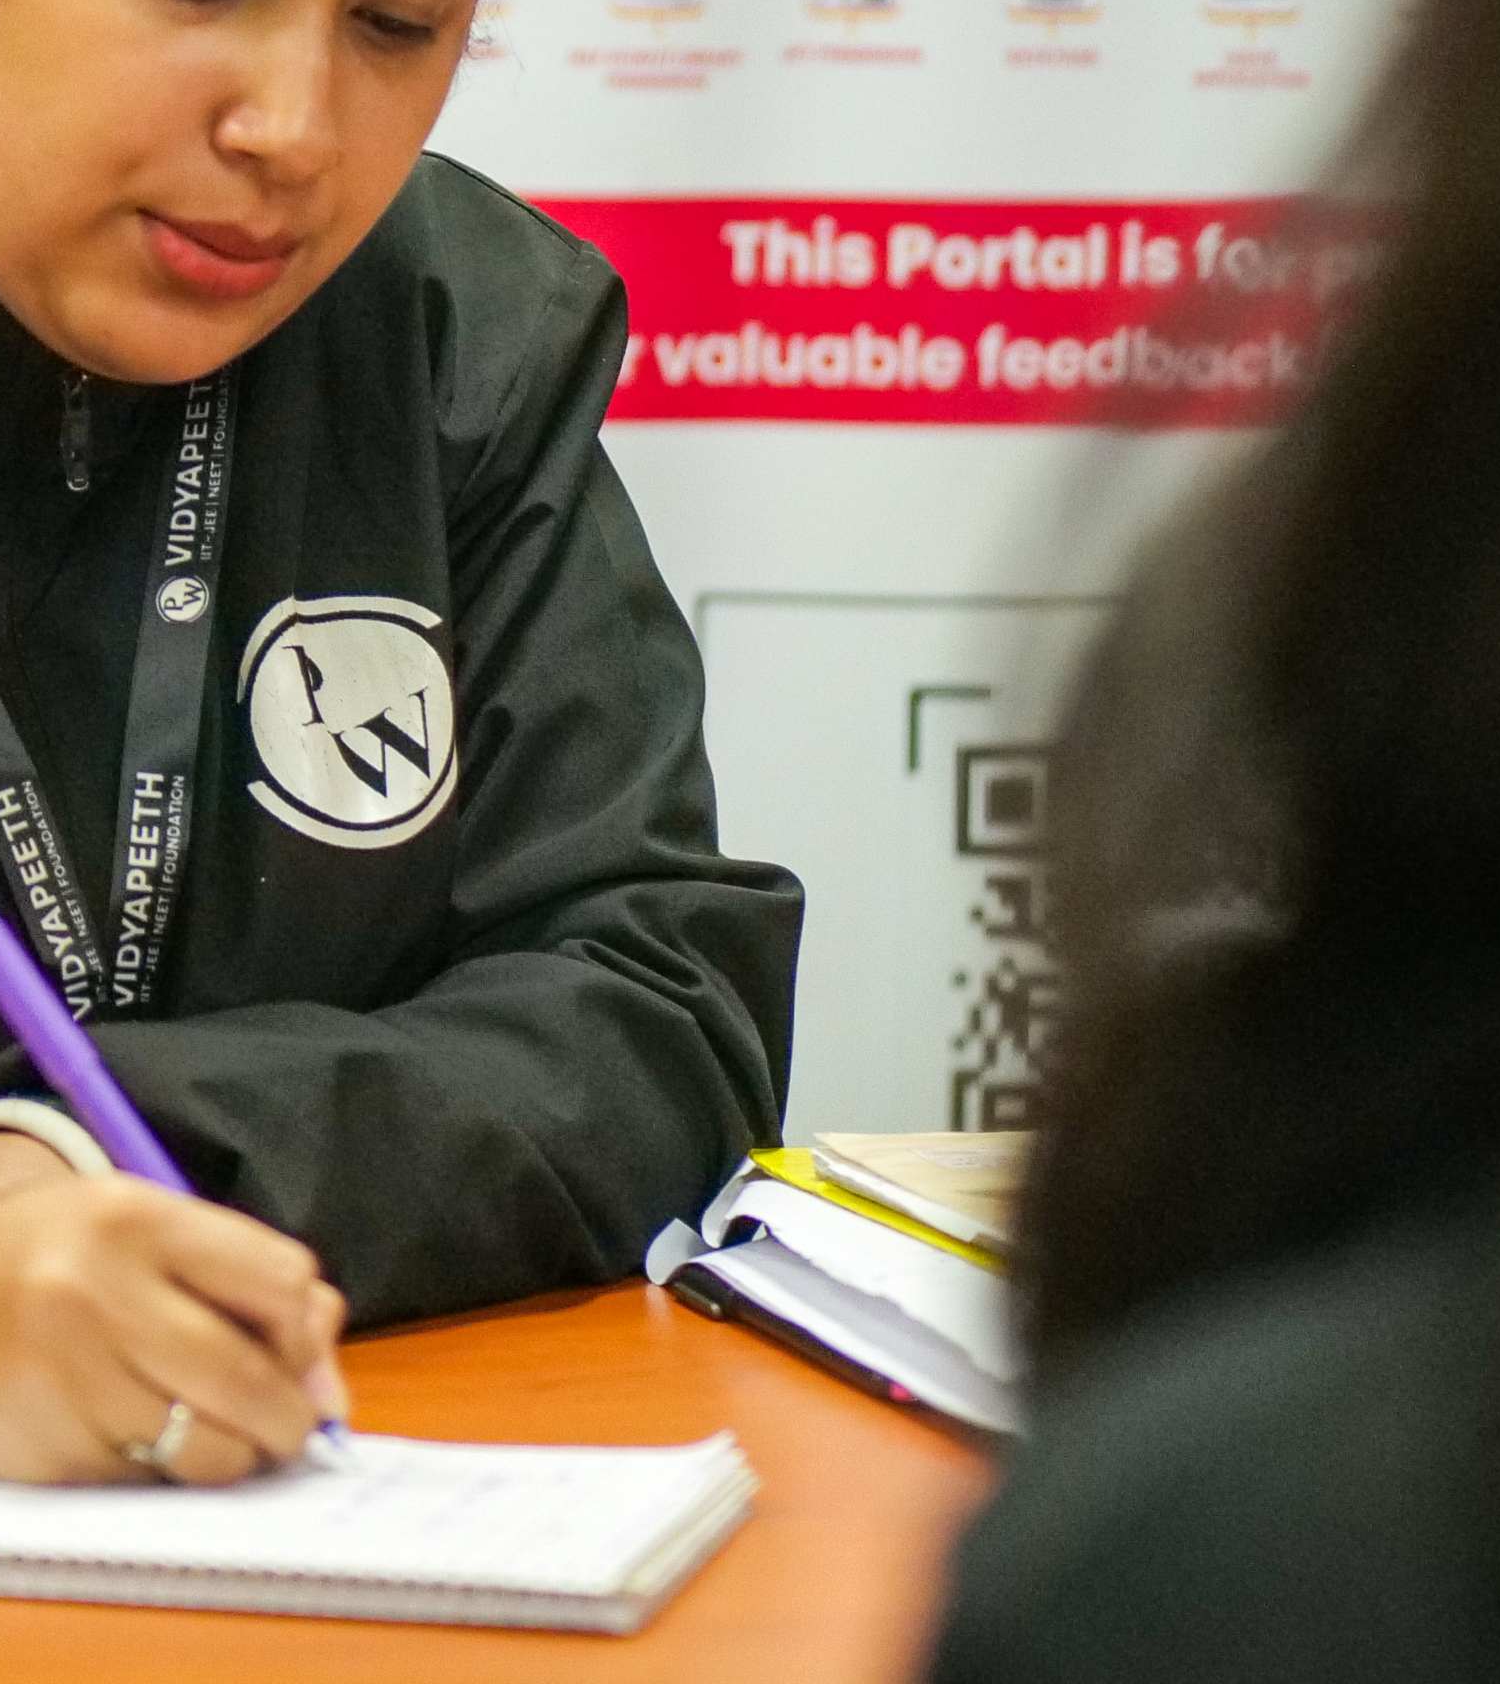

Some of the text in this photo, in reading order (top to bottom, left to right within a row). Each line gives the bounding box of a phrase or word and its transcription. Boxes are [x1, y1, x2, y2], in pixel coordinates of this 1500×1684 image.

[720, 215, 876, 290] This
[886, 222, 1107, 292] Portal
[1119, 219, 1181, 290] is
[653, 319, 967, 392] valuable
[164, 379, 213, 566] VIDYAPEET
[208, 461, 223, 498] NEET
[21, 781, 70, 888] FOUNDATION
[162, 775, 185, 884] FOUNDATION
[112, 771, 165, 1007] VIDYAPEETH
